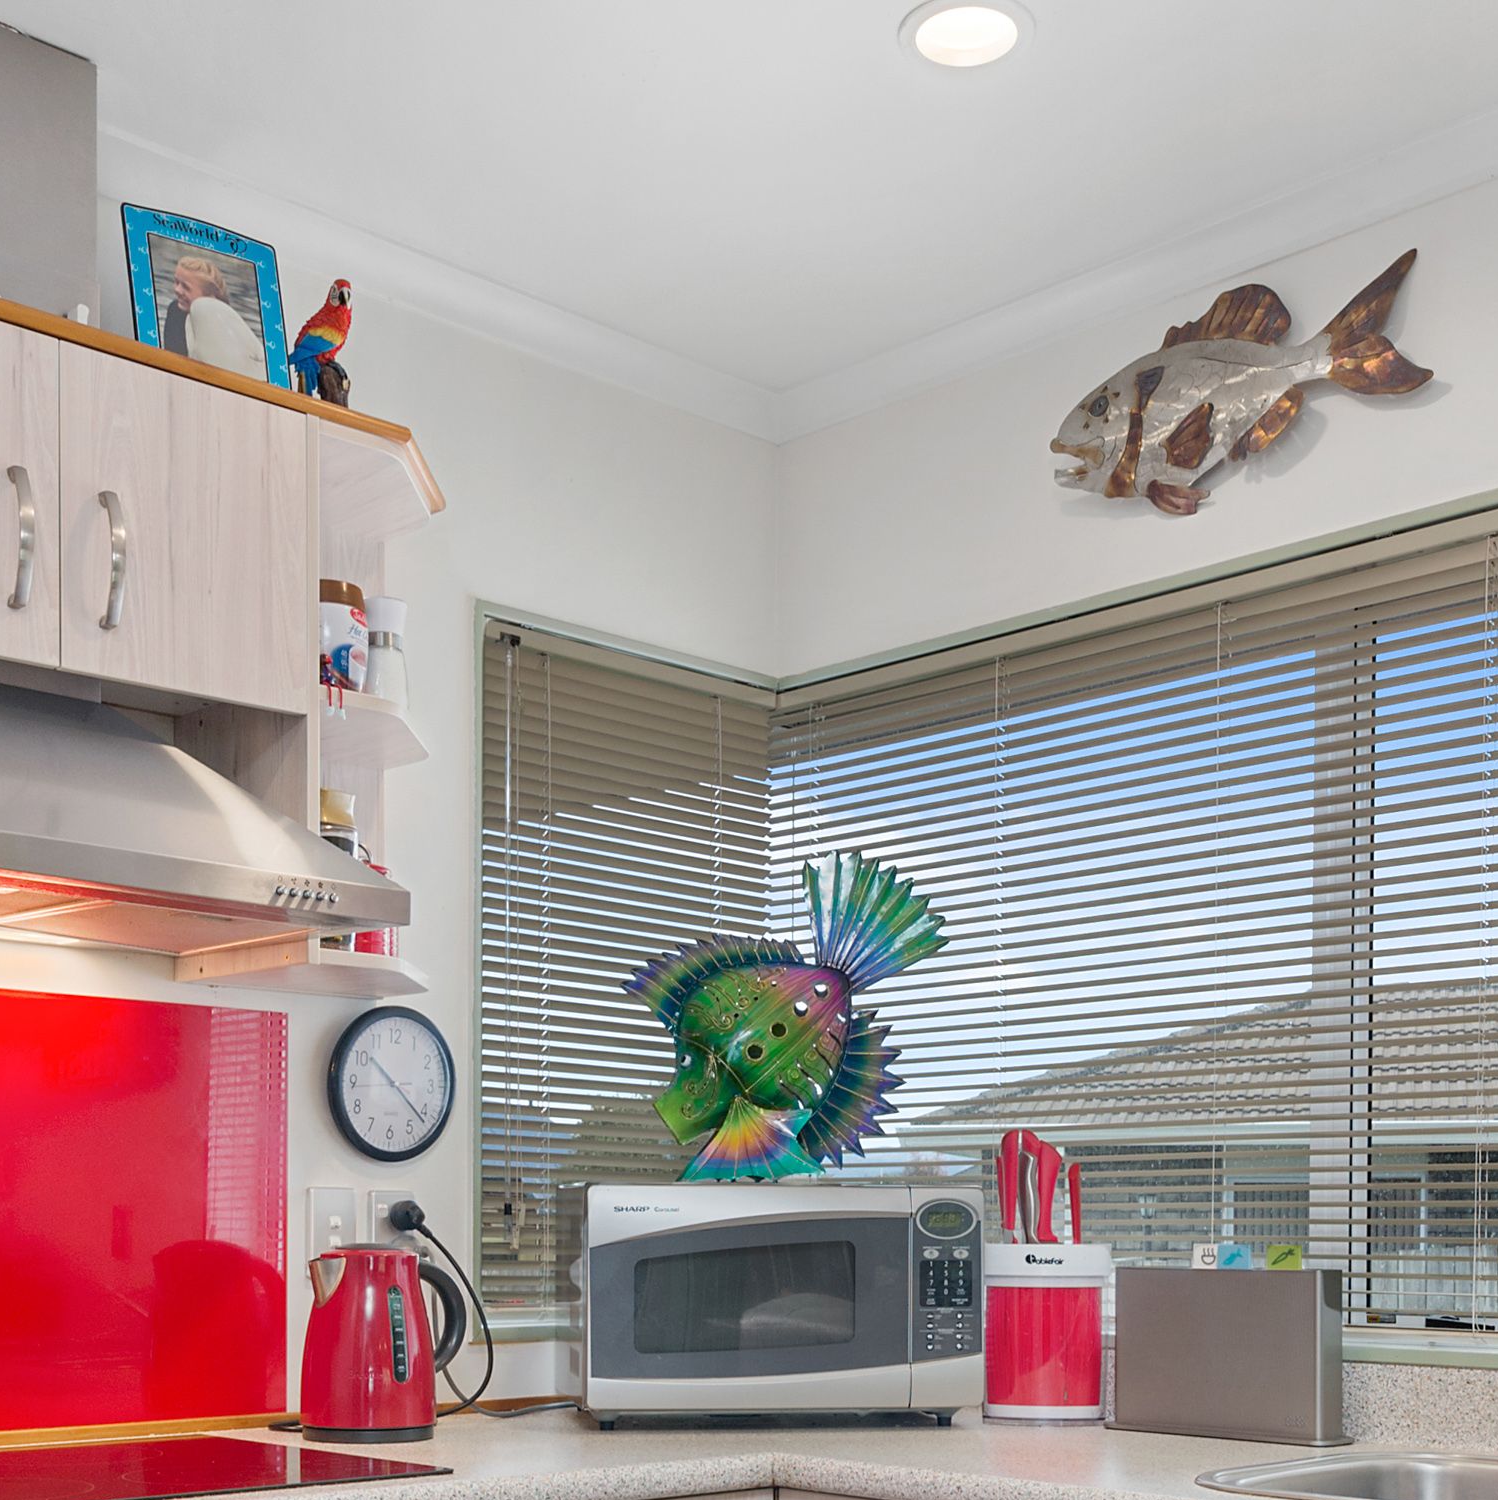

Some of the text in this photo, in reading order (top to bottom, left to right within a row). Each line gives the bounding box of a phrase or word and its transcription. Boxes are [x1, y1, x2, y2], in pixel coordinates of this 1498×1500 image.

[152, 213, 220, 242] SeaWorld
[371, 1034, 381, 1049] 11
[389, 1028, 402, 1044] 12
[355, 1050, 368, 1067] 10
[424, 1054, 431, 1070] 2
[349, 1074, 357, 1089] 9
[427, 1079, 434, 1094] 3
[353, 1099, 361, 1114] 8
[420, 1103, 428, 1117] 4
[368, 1117, 375, 1132] 7
[386, 1124, 394, 1140] 6
[406, 1119, 414, 1135] 5
